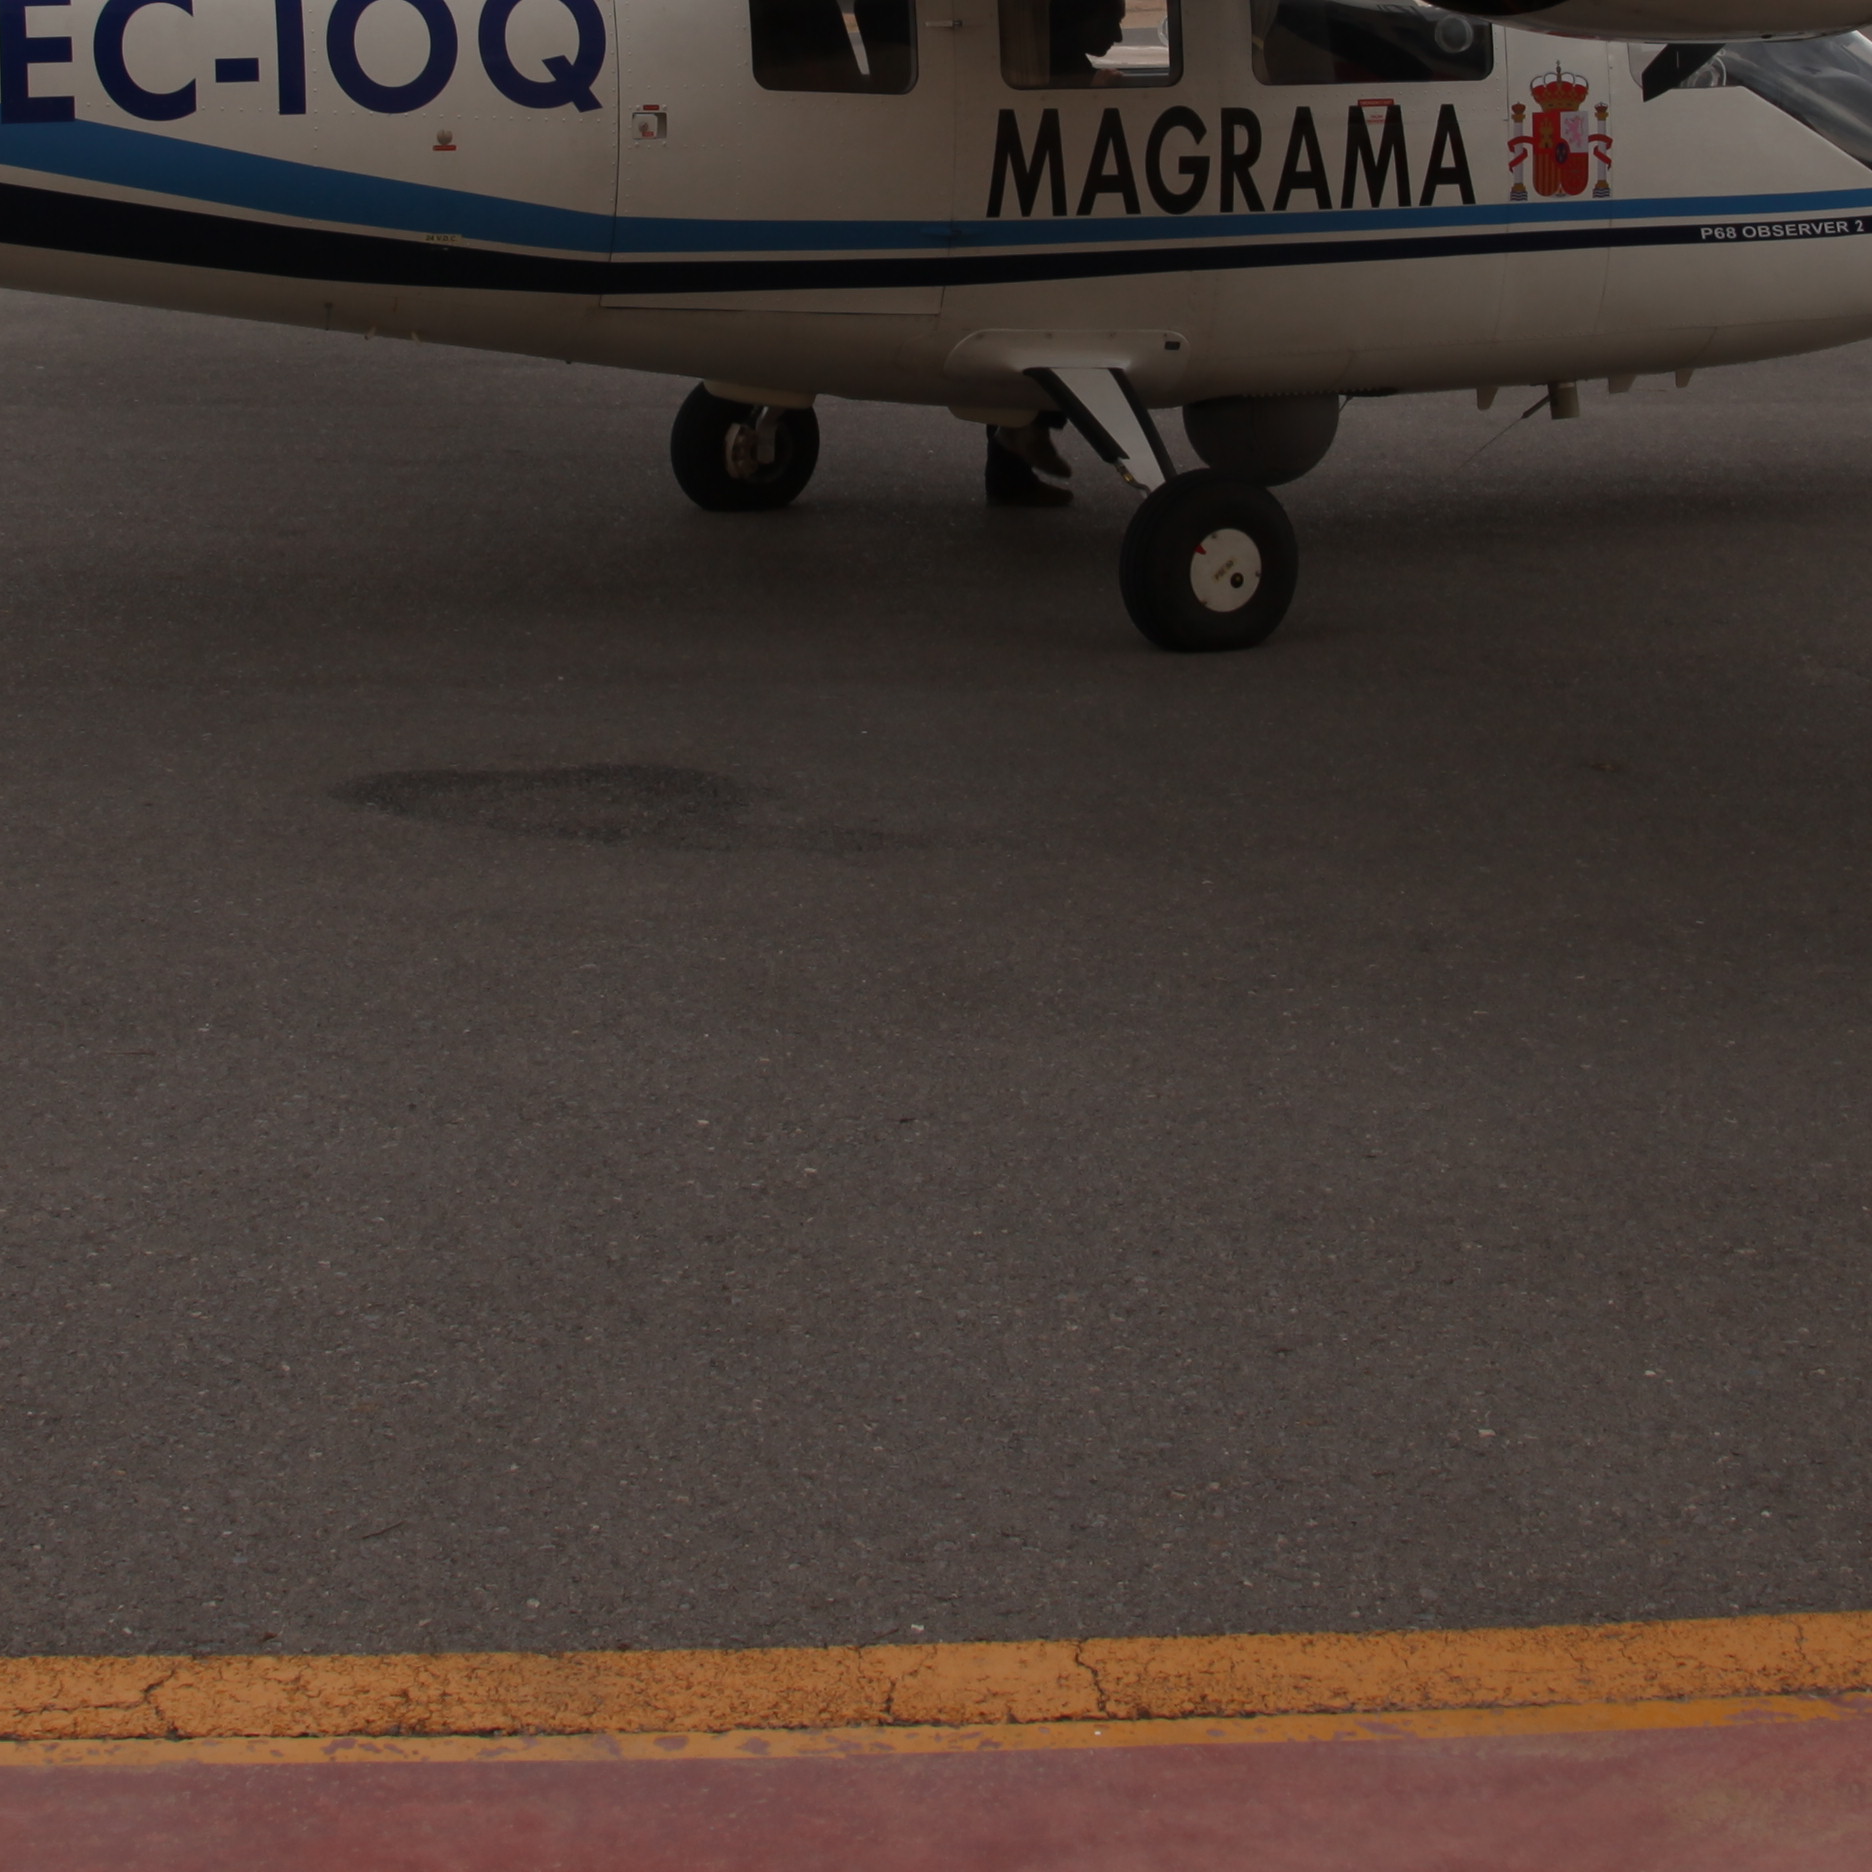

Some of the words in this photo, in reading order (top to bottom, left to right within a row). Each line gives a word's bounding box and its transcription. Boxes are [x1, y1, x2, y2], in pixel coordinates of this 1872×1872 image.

[986, 104, 1476, 218] MAGRAMA
[1700, 226, 1737, 240] P68
[1742, 220, 1849, 238] OBSERVER
[1855, 219, 1865, 232] 2
